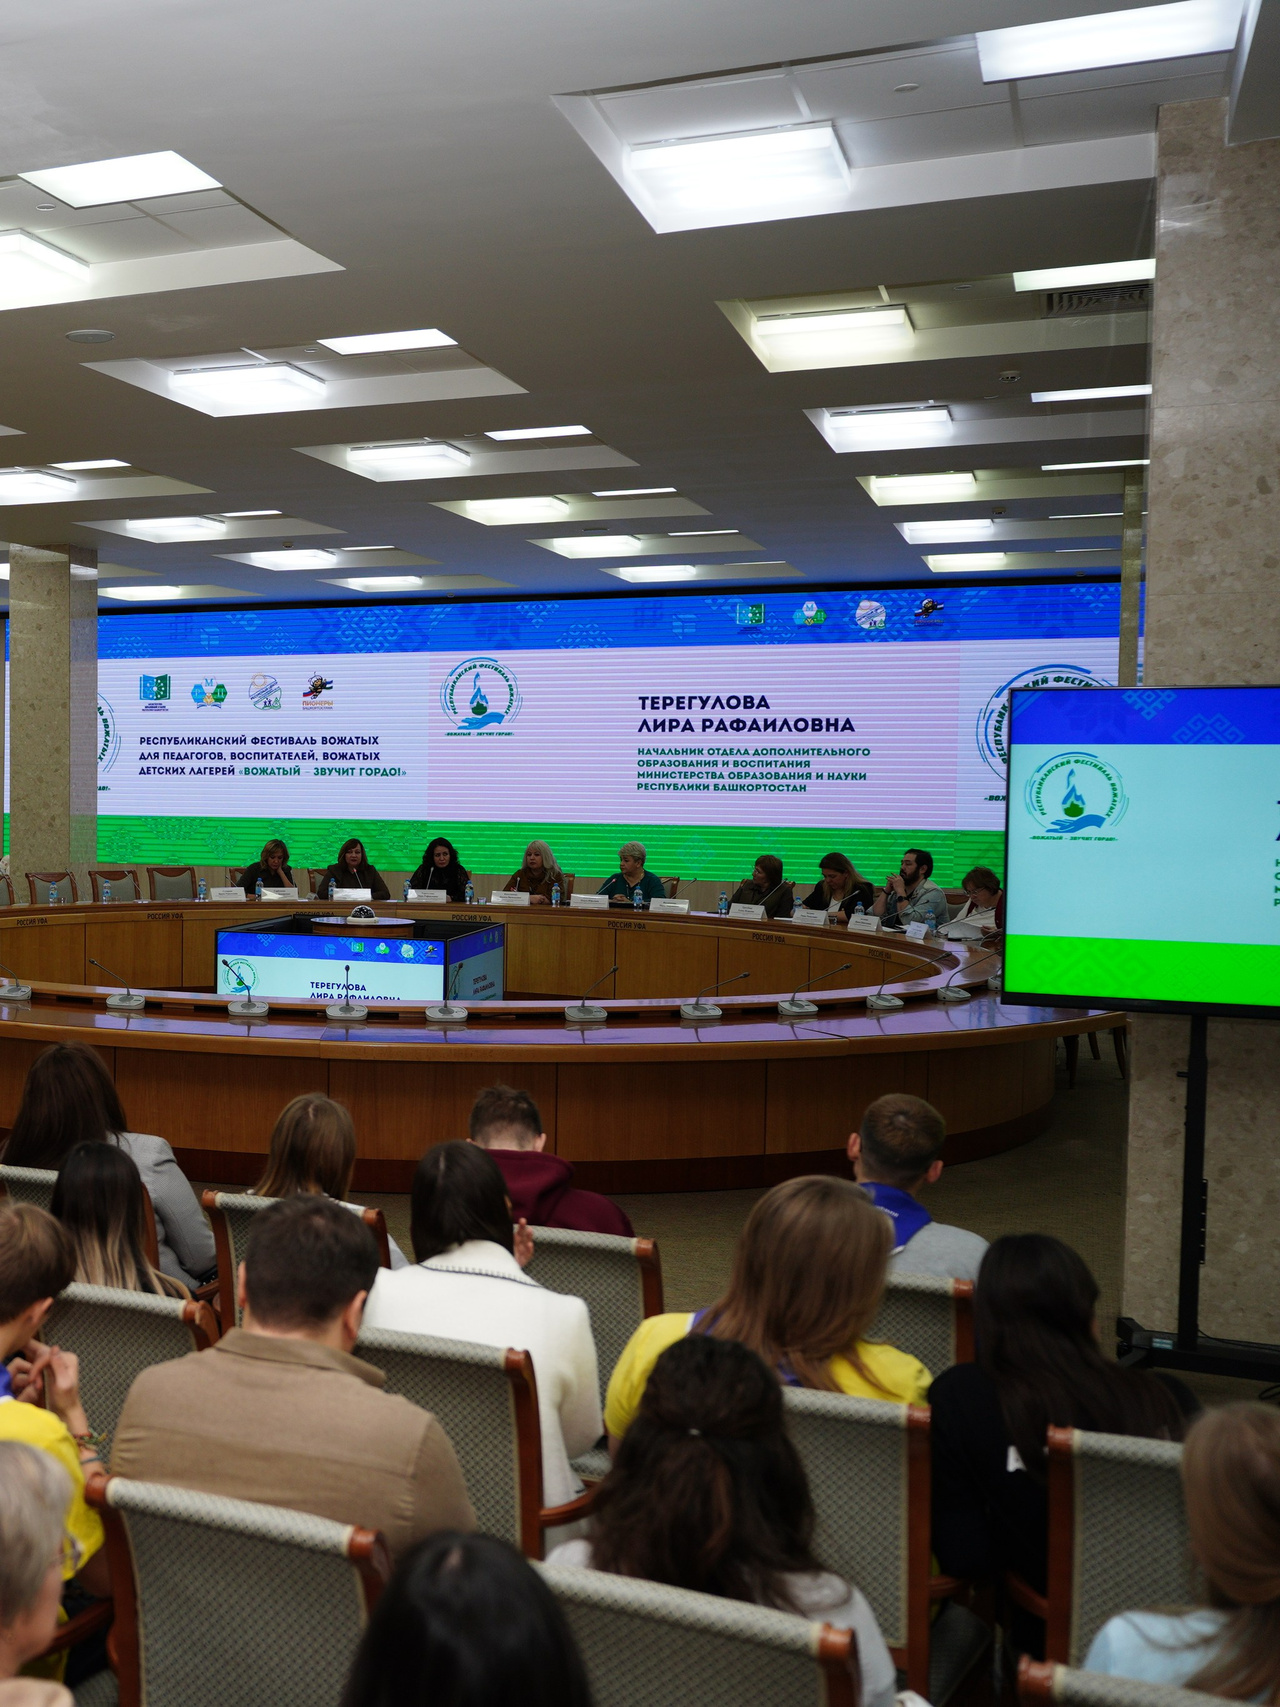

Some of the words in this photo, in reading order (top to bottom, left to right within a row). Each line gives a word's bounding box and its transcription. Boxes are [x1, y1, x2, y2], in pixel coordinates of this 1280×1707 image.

[638, 695, 771, 710] ТЕРЕГУЛОВА
[637, 718, 696, 733] ЛИРА
[701, 717, 856, 733] РАФАИЛОВНА
[139, 735, 247, 745] РЕСПУБЛИКАНСКИЙ
[250, 736, 317, 745] ФЕСТИВАЛЬ
[321, 736, 379, 745] ВОЖАТЫХ
[139, 751, 160, 761] ДЛЯ
[163, 752, 227, 761] ПЕДАГОГОВ,
[230, 750, 318, 761] ВОСПИТАТЕЛЕЙ,
[322, 752, 380, 761] ВОЖАТЫХ
[637, 747, 704, 756] НАЧАЛЬНИК
[706, 747, 750, 757] ОТДЕЛА
[752, 748, 871, 757] ДОПОЛНИТЕЛЬНОГО
[637, 759, 719, 768] ОБРАЗОВАНИЯ
[722, 759, 729, 768] И
[732, 759, 811, 769] ВОСПИТАНИЯ
[139, 766, 186, 776] ДЕТСКИХ
[188, 765, 235, 776] ЛАГЕРЕЙ
[239, 765, 301, 776] «ВОЖАТЫЙ
[313, 767, 356, 776] ЗВУЧИТ
[359, 767, 407, 777] ГОРДО!»
[637, 771, 725, 780] МИНИСТЕРСТВА
[727, 771, 812, 781] ОБРАЗОВАНИЯ
[815, 772, 823, 781] И
[827, 772, 867, 781] НАУКИ
[637, 783, 710, 791] РЕСПУБЛИКИ
[712, 783, 807, 793] БАШКОРТОСТАН
[16, 918, 37, 926] РОССИЯ
[37, 917, 48, 925] УФА
[451, 914, 478, 922] РОССИЯ
[607, 921, 632, 929] РОССИЯ
[633, 922, 646, 930] УФА
[752, 932, 774, 942] РОССИЯ
[774, 934, 786, 944] УФА
[310, 981, 367, 992] ТЕРЕГУЛОВА
